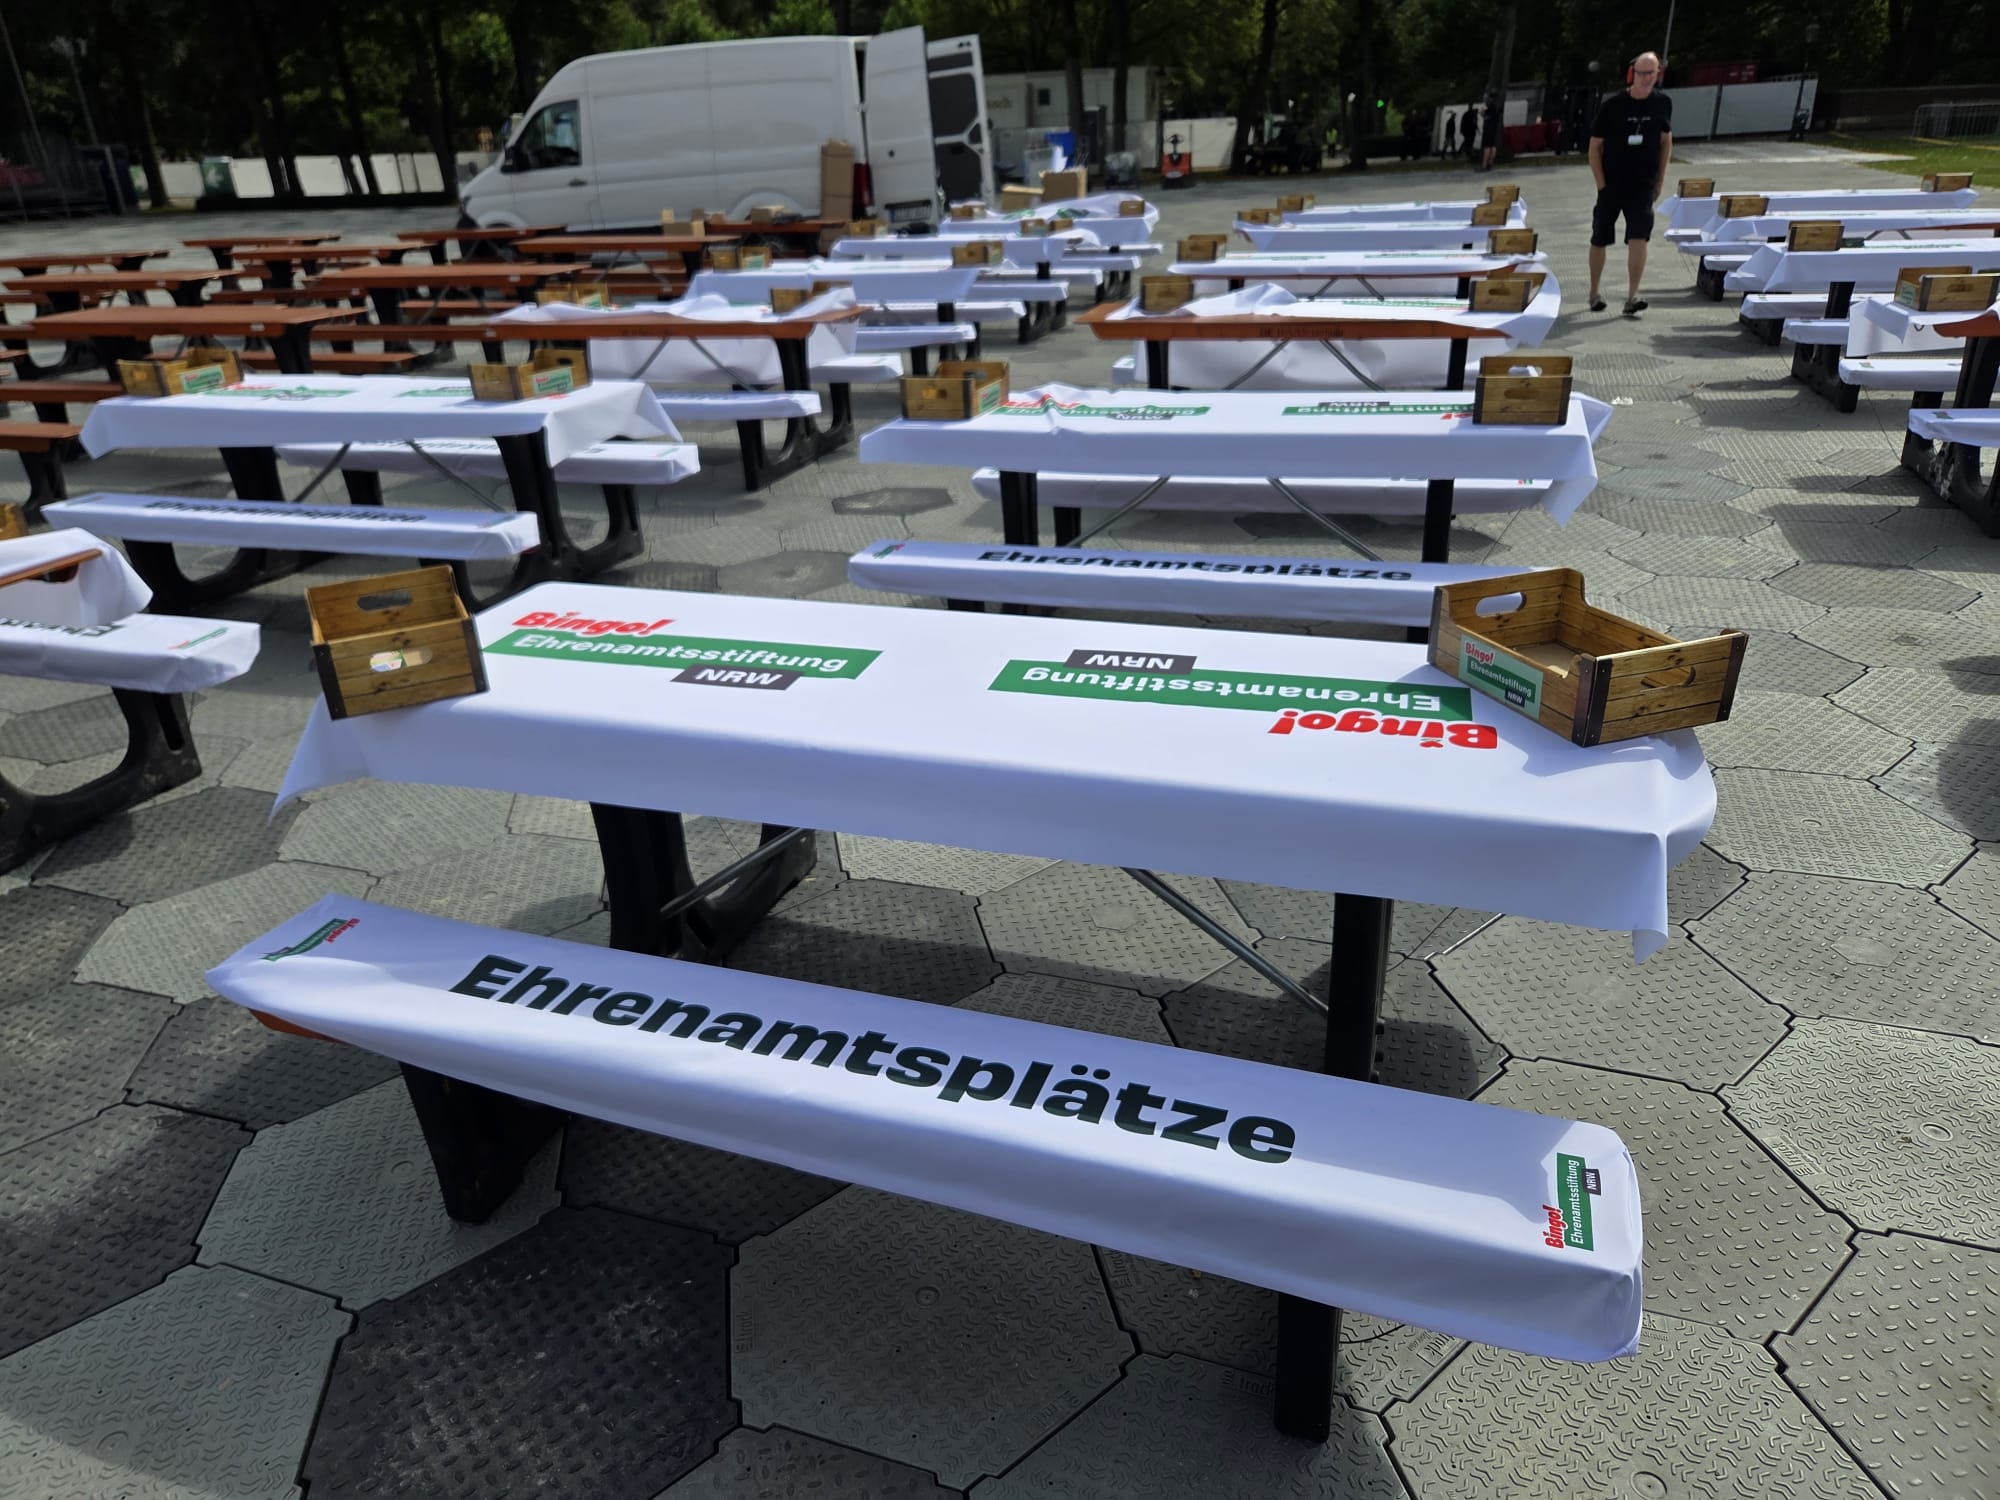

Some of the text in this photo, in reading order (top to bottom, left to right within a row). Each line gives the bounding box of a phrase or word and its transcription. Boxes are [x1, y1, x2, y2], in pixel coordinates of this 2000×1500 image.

[977, 551, 1412, 581] Ehrenamtsplätze
[512, 611, 676, 637] Bingo!
[513, 633, 849, 672] Ehrenamtsstiftung
[1085, 653, 1174, 670] NRW
[1465, 642, 1494, 664] Bingo!
[694, 668, 782, 686] NRW
[1022, 667, 1441, 712] Ehrenamtsstiftung
[1470, 661, 1532, 697] Ehrenamtsstiftung
[1507, 691, 1523, 703] NRW
[1267, 708, 1498, 749] Bingo!
[449, 954, 1296, 1163] Ehrenamtsplätze
[1586, 1171, 1598, 1190] NRW
[1566, 1159, 1585, 1245] Ehrenamtsstiftung
[1542, 1204, 1567, 1249] Bingo!
